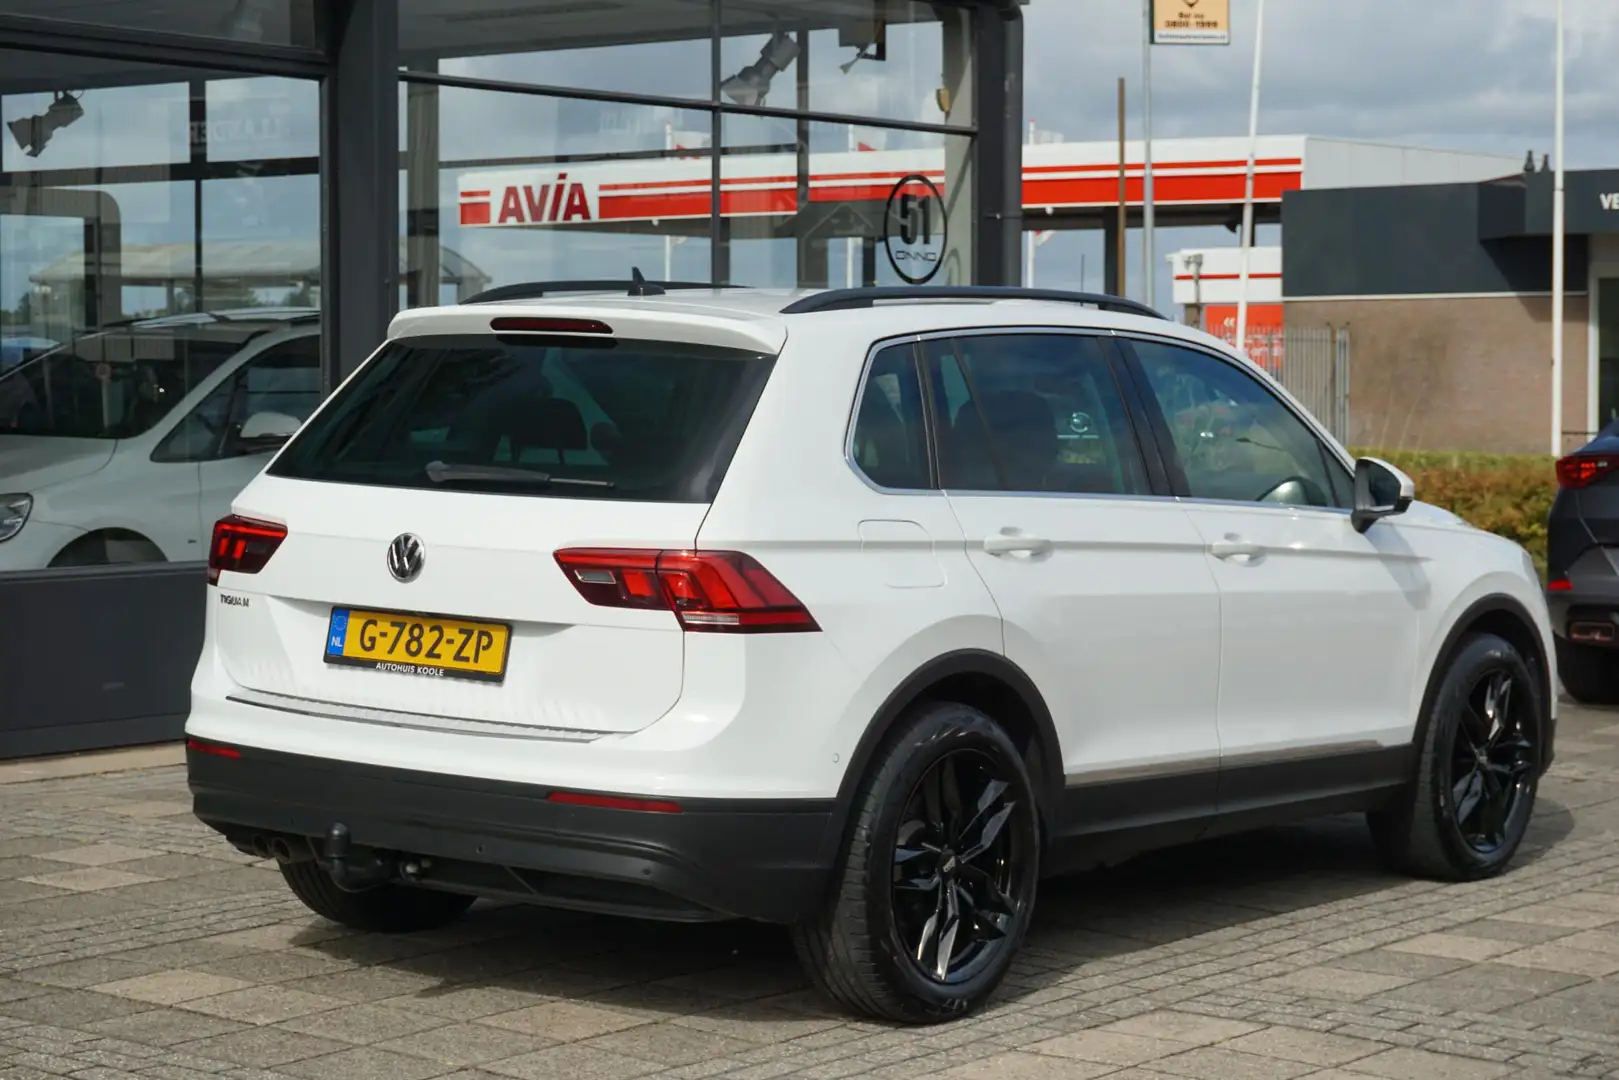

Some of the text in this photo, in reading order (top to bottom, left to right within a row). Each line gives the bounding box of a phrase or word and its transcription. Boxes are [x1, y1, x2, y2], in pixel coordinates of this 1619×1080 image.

[498, 172, 591, 223] AVIA
[900, 194, 930, 245] 51
[331, 636, 343, 648] NL
[359, 619, 493, 664] G-782-ZP
[376, 662, 445, 677] AUTOHUIS KOOLE
